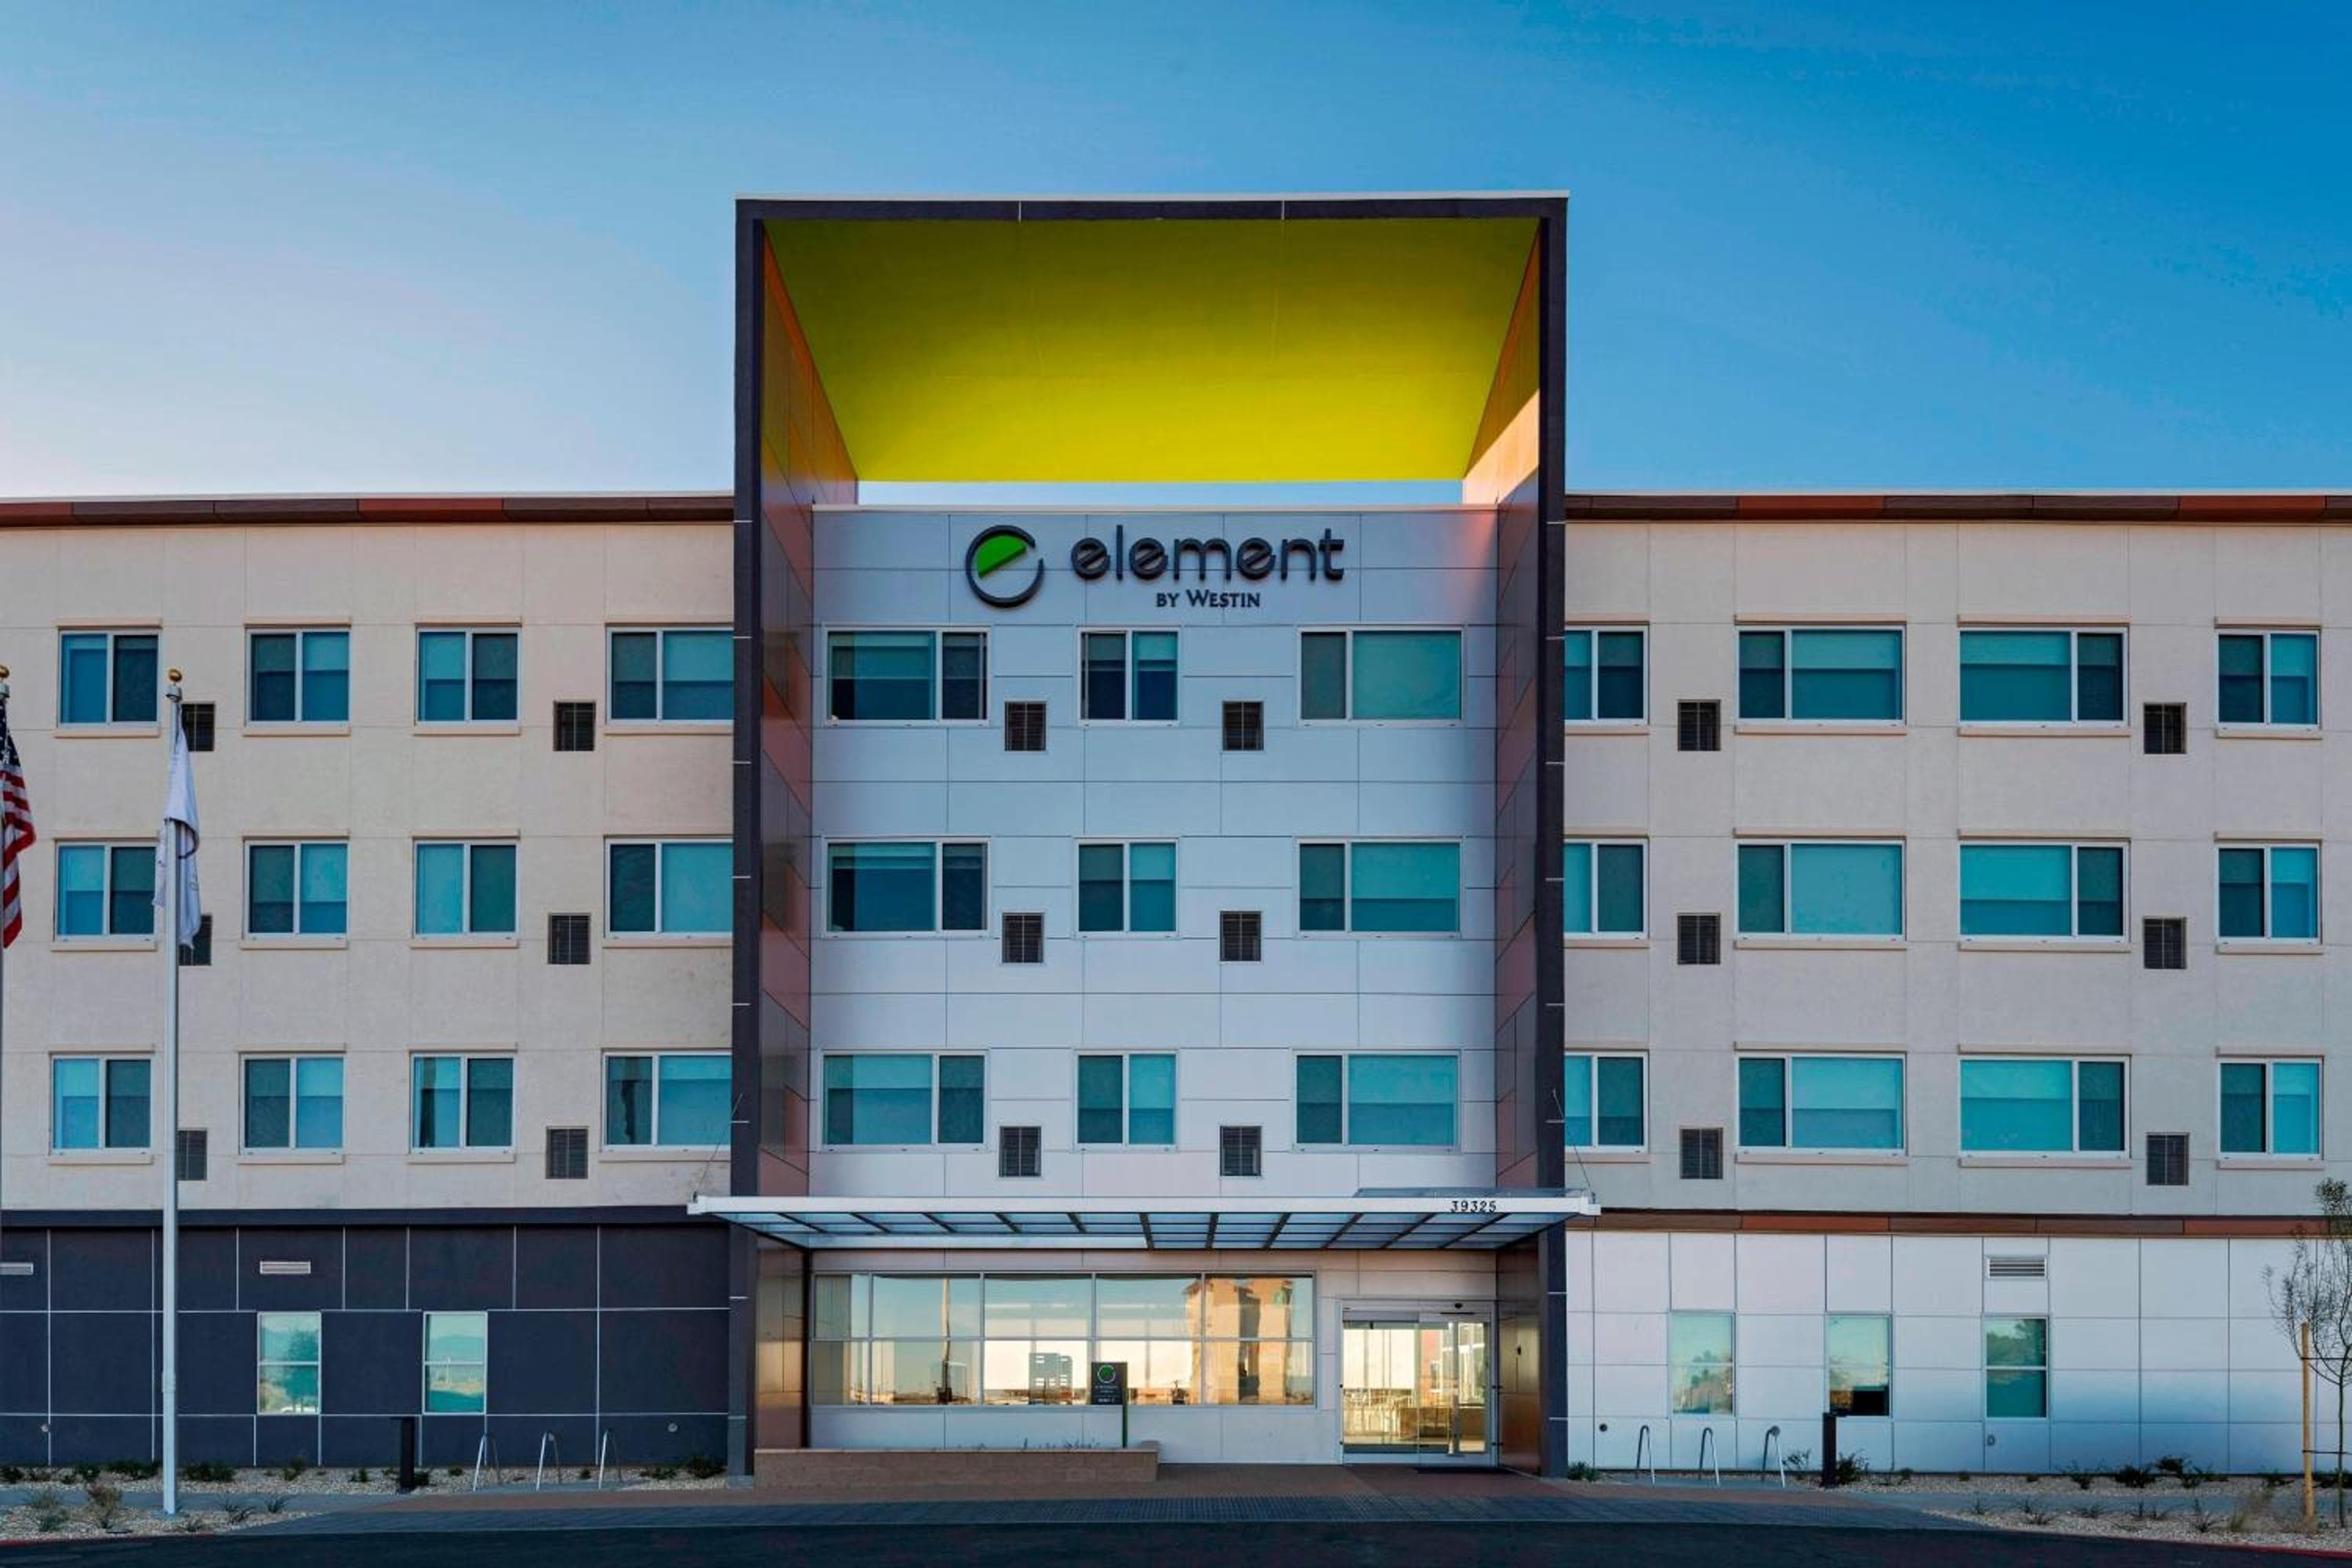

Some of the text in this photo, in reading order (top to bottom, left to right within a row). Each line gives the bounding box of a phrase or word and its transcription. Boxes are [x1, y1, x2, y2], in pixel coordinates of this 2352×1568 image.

[1071, 524, 1345, 582] element
[1156, 592, 1180, 608] BY
[1450, 1200, 1497, 1213] 39325
